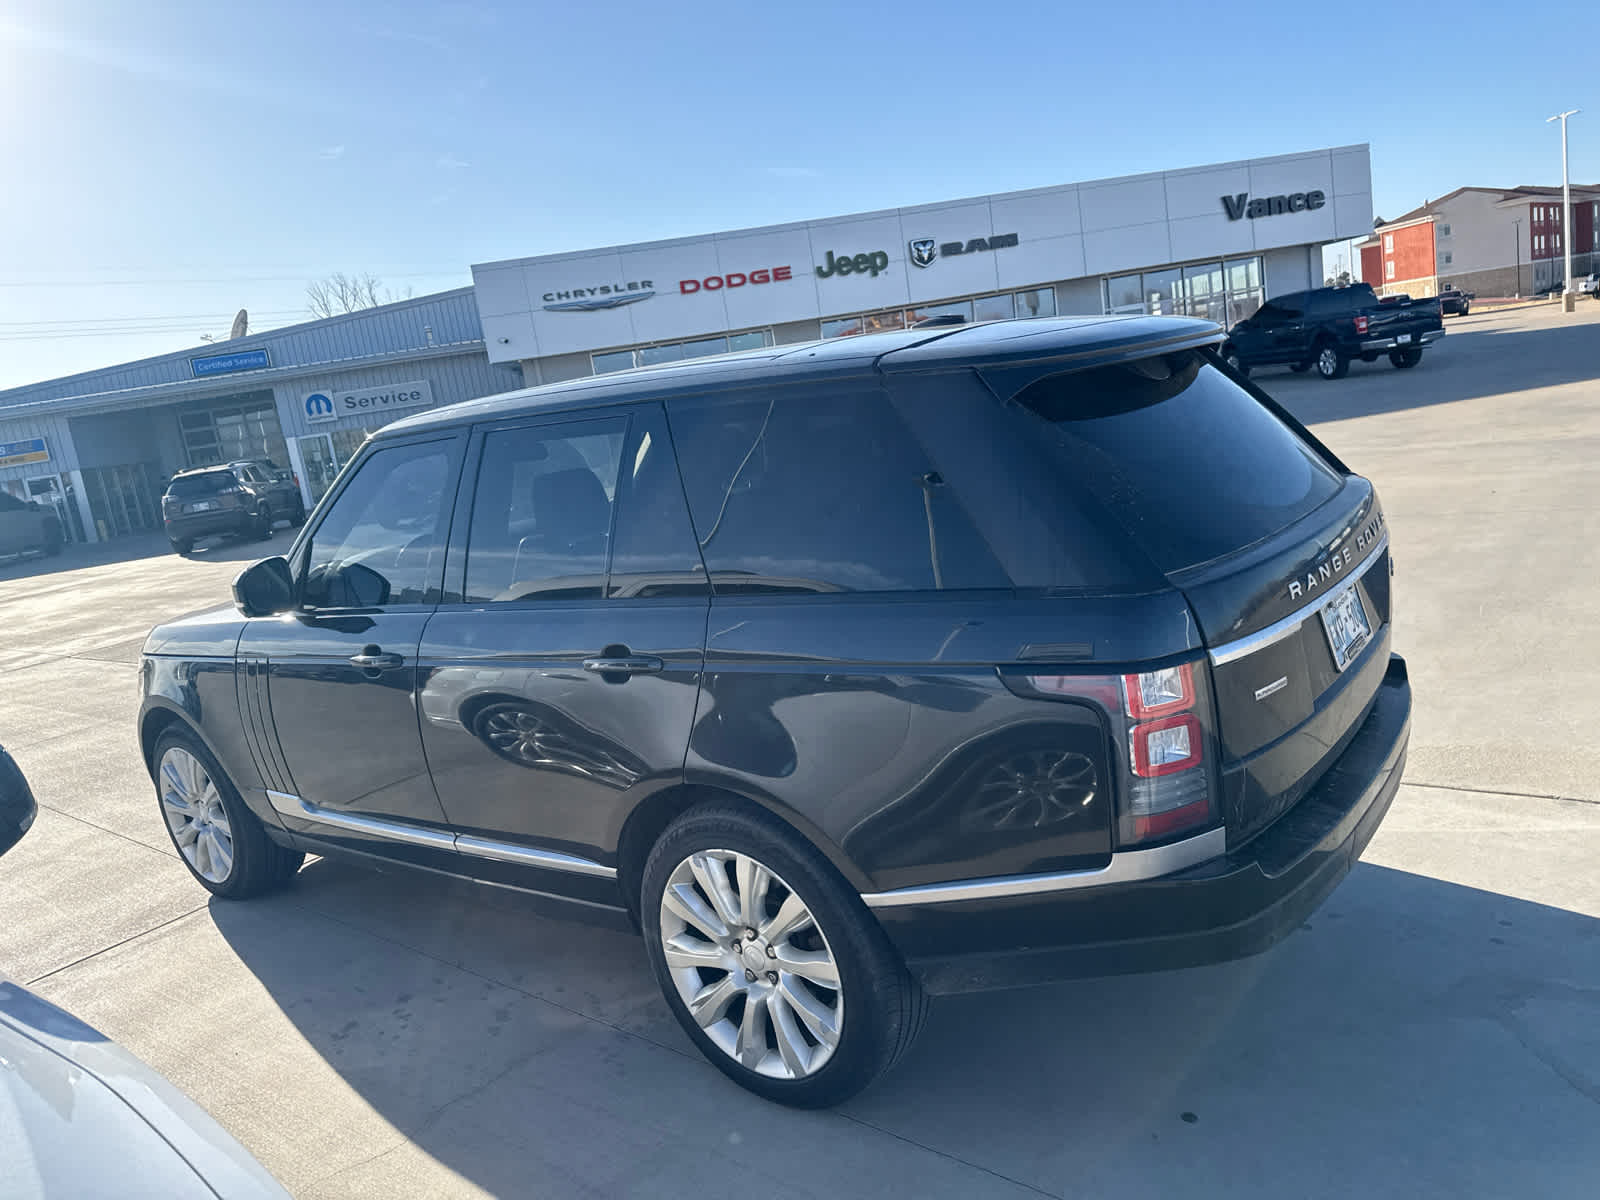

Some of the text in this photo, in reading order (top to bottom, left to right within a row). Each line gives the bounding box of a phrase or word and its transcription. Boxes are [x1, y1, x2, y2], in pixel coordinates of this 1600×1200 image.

[1220, 189, 1326, 222] Vance
[940, 233, 1019, 258] RAM
[815, 250, 889, 279] Jeep
[542, 279, 655, 303] CHRYSLER
[679, 265, 793, 296] DODGE
[344, 389, 421, 409] Service
[1288, 546, 1353, 600] RANGE
